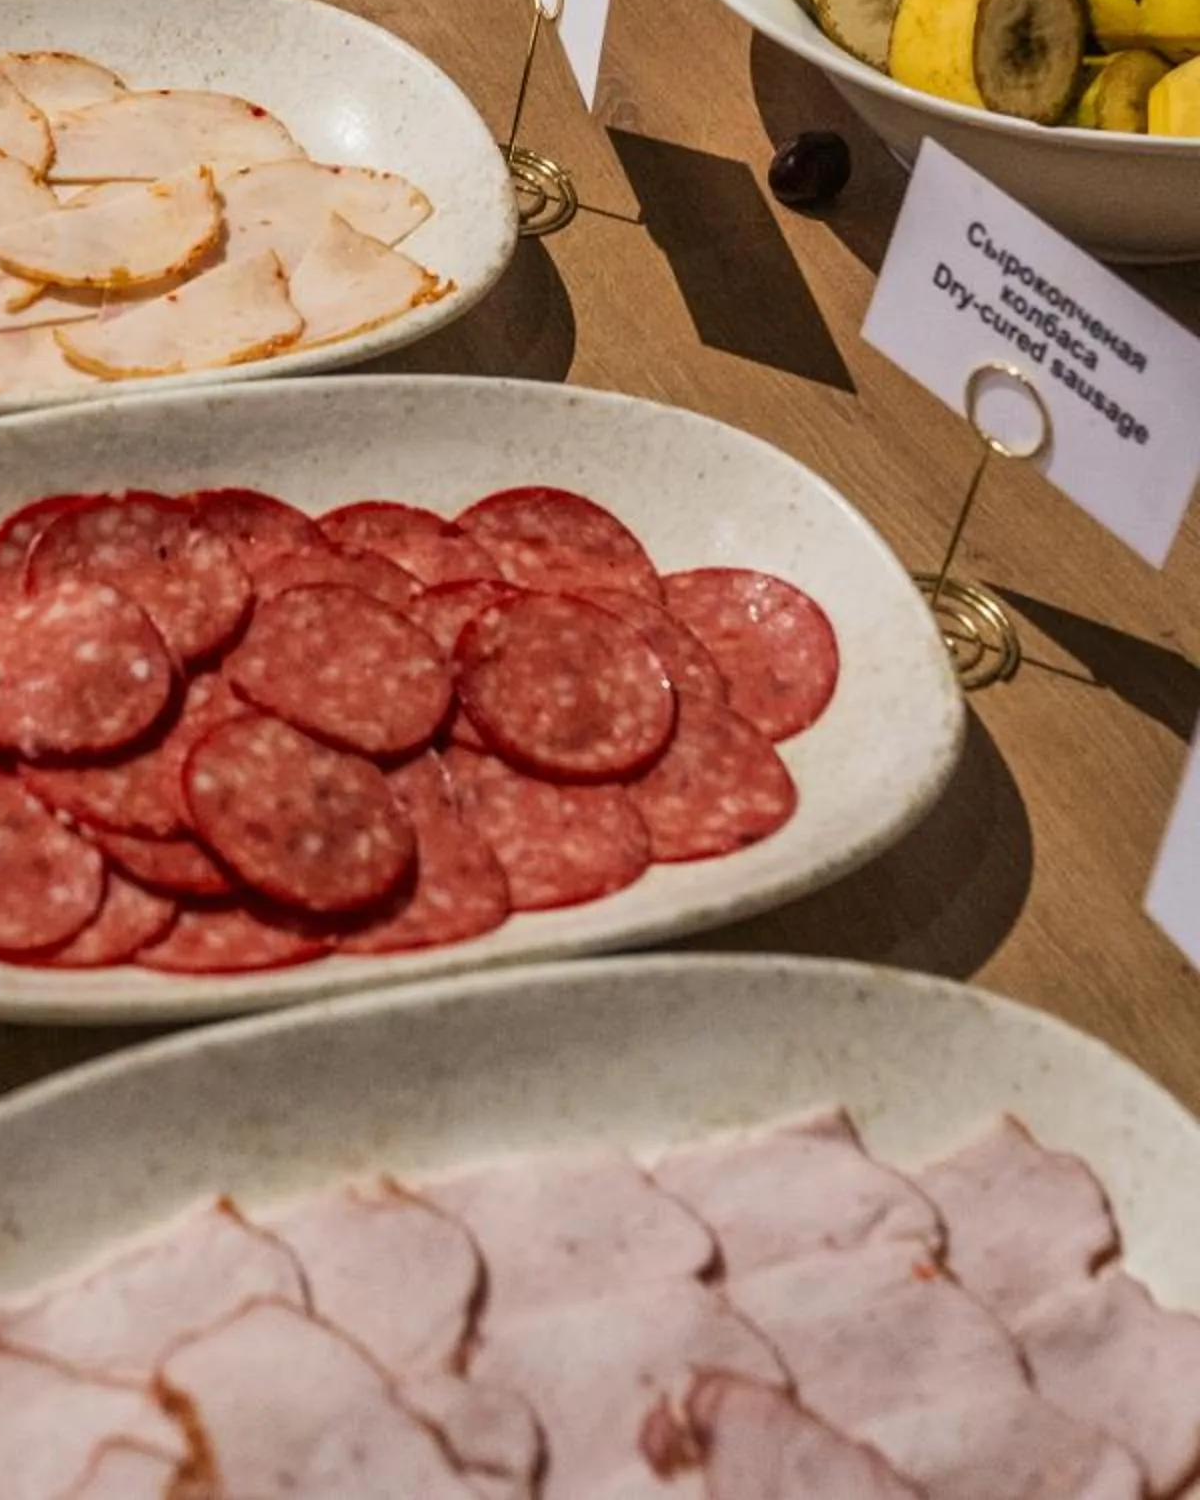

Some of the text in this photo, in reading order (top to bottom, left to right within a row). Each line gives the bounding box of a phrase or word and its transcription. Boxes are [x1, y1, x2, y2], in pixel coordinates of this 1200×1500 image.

[932, 262, 1150, 445] Dry-cured sausage
[966, 221, 1148, 374] Сырокопченая
[999, 284, 1099, 372] колбаса
